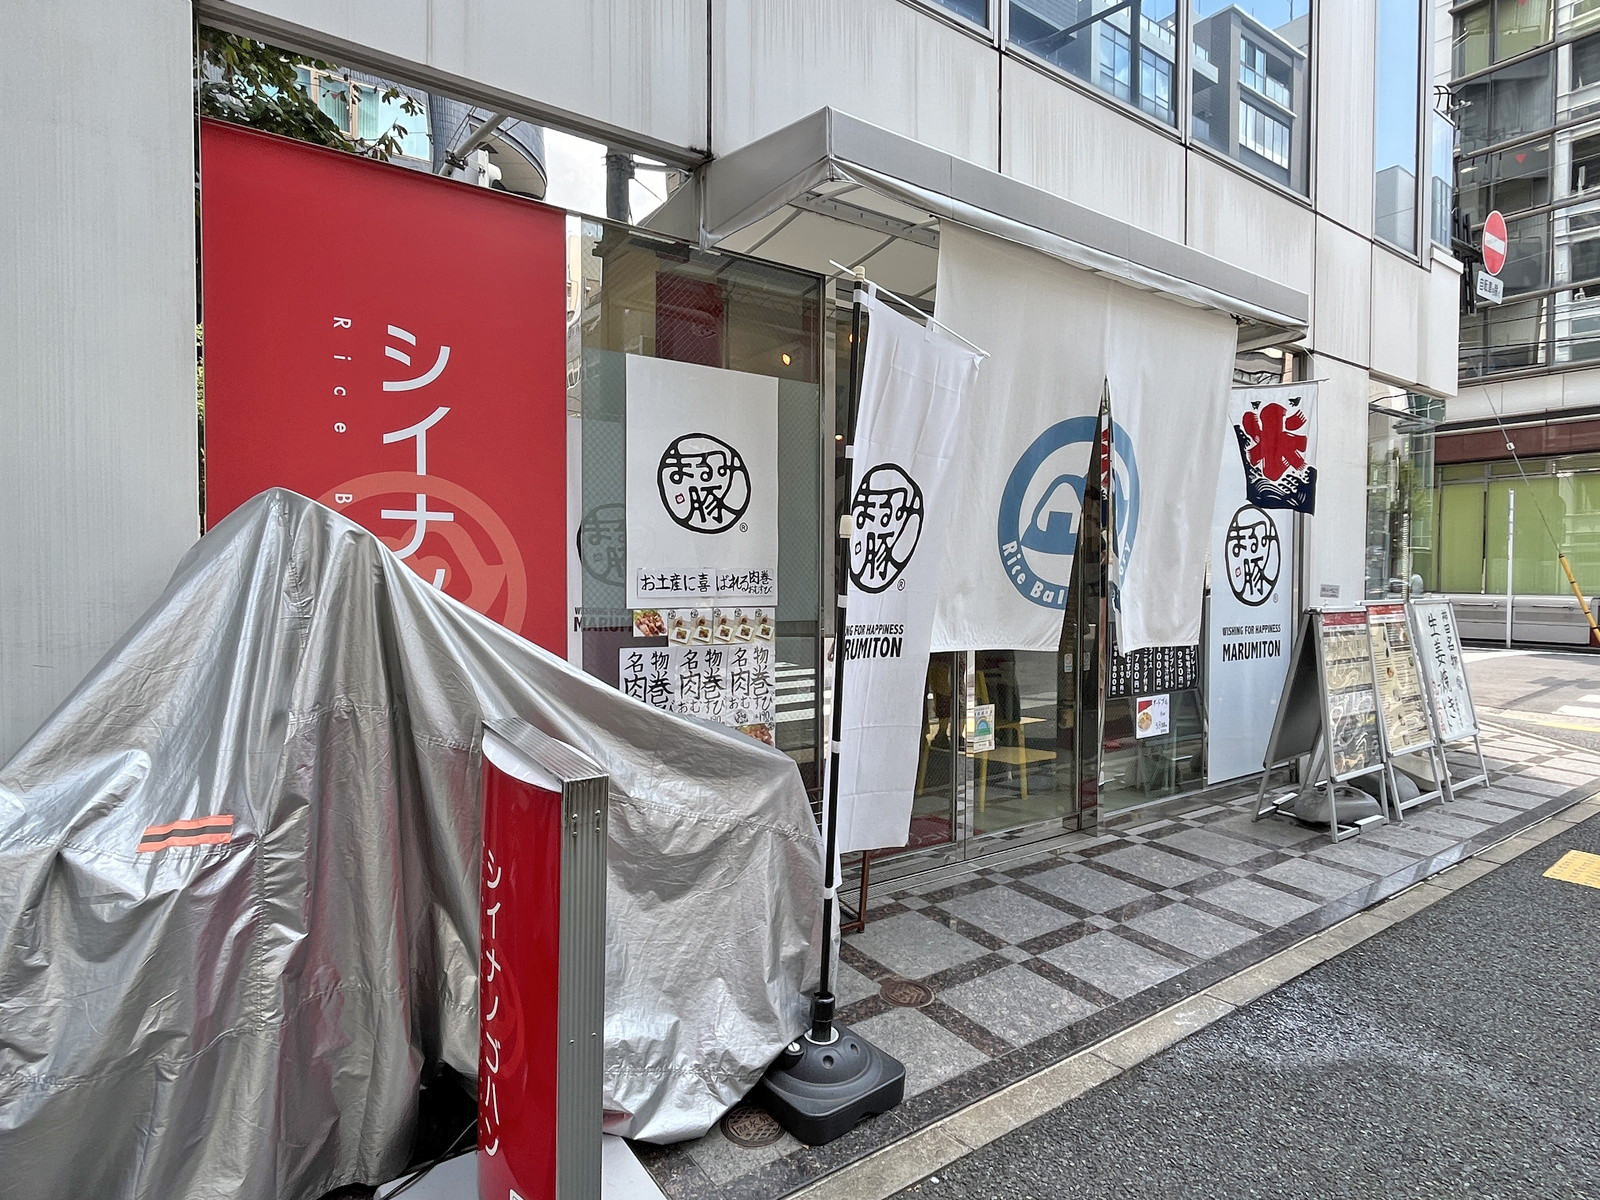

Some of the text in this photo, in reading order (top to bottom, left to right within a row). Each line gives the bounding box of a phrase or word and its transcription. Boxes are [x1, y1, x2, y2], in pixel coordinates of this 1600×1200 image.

[333, 317, 352, 434] Rice
[1242, 403, 1308, 481] 氷
[1002, 541, 1065, 605] Rice Bal
[573, 617, 633, 632] MARUM
[854, 625, 865, 635] FOR
[866, 624, 904, 635] HAPPINESS
[1222, 624, 1281, 636] WISHING FOR HAPPINESS
[680, 648, 723, 670] 名物
[731, 646, 769, 667] 名物
[845, 637, 903, 660] RUMITON
[1222, 640, 1281, 662] MARUMITON
[624, 651, 670, 673] 名物
[680, 668, 728, 700] 肉巻
[731, 665, 775, 697] 肉巻
